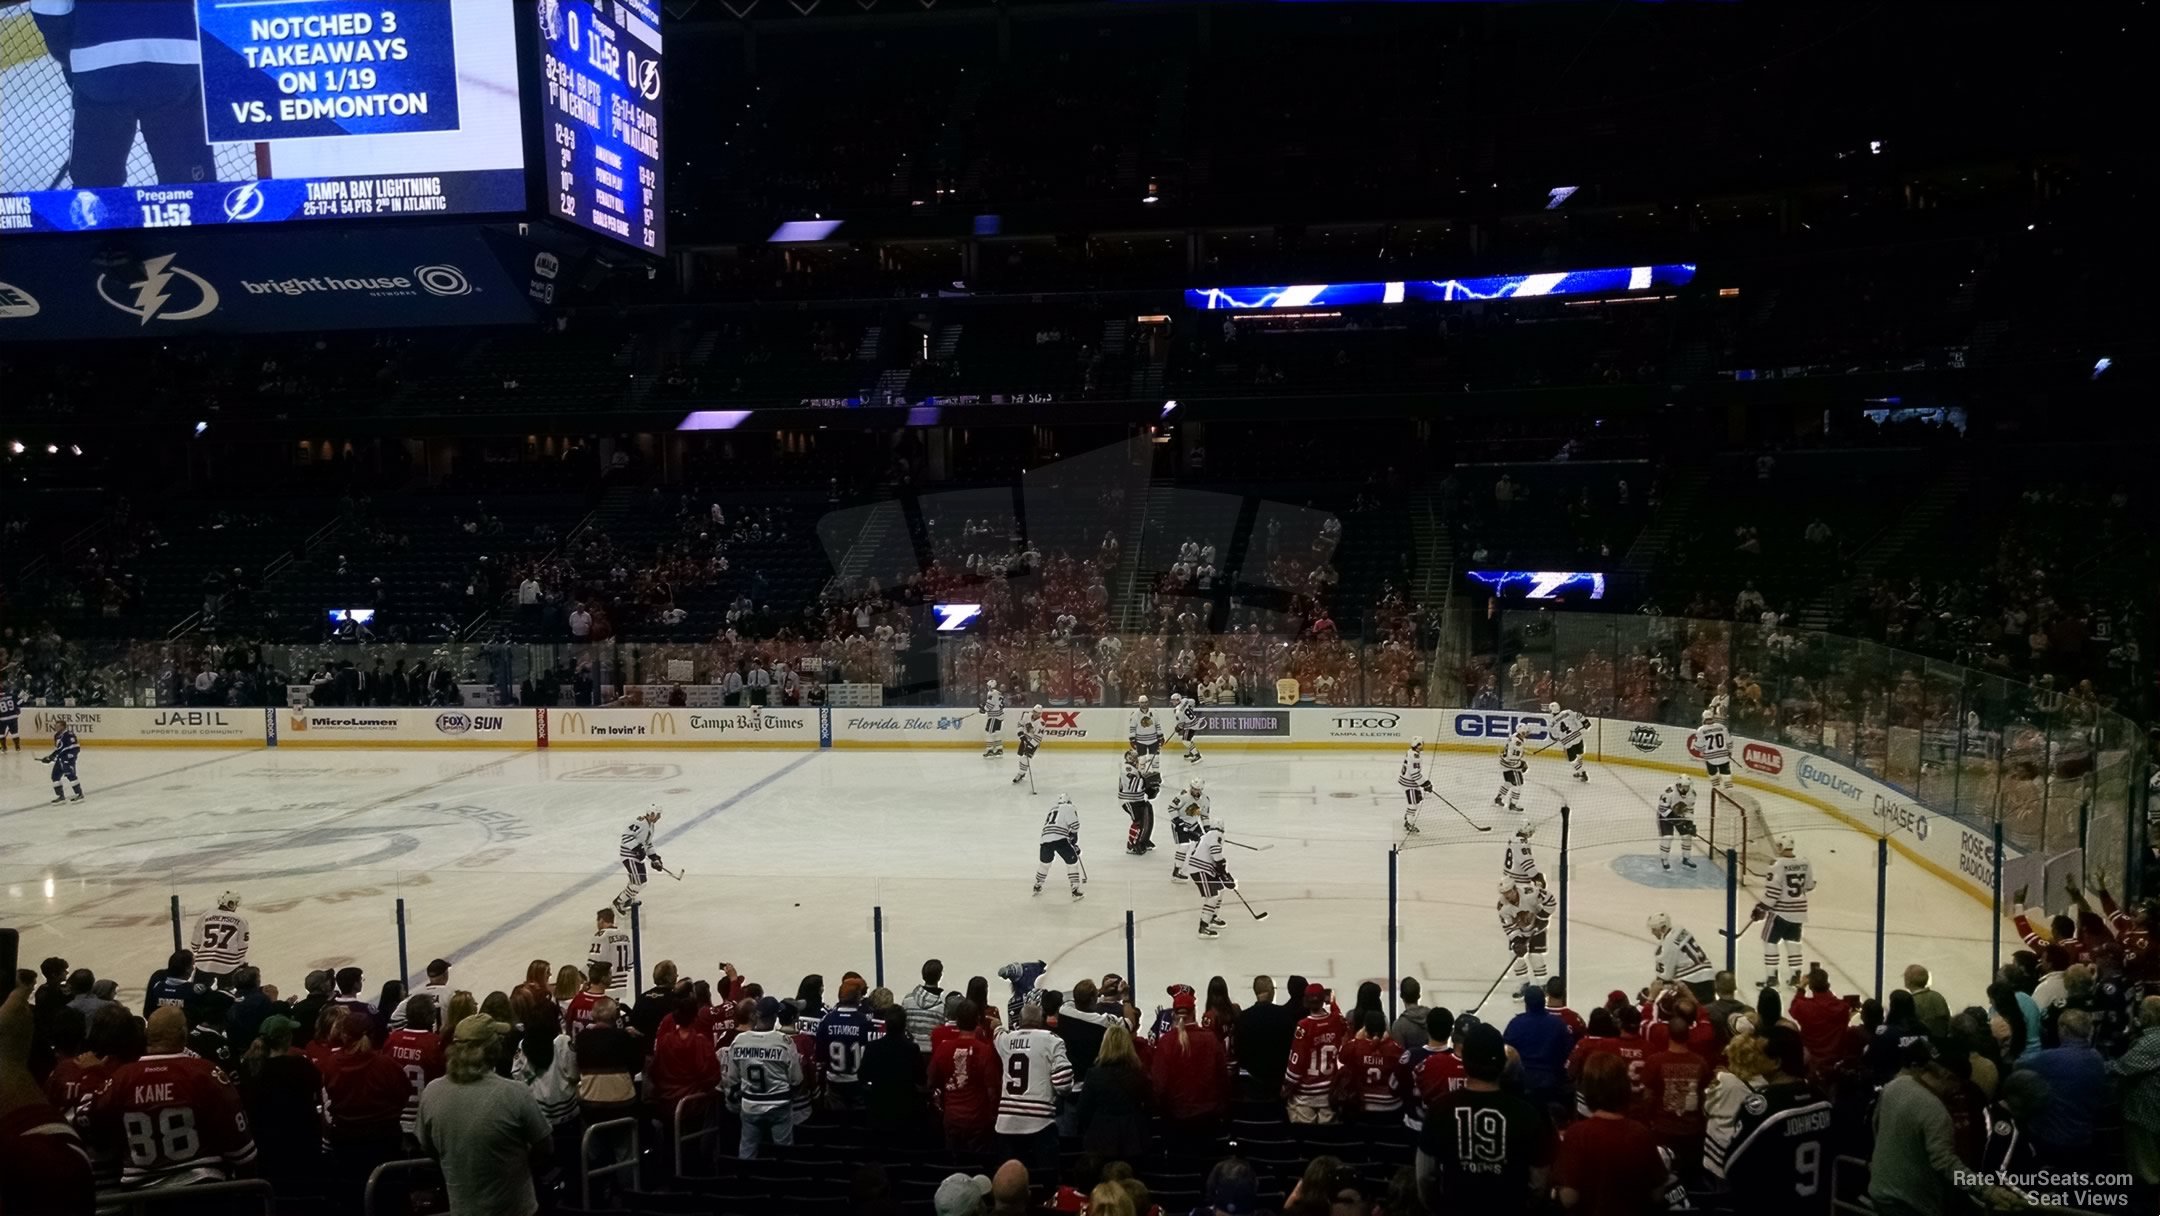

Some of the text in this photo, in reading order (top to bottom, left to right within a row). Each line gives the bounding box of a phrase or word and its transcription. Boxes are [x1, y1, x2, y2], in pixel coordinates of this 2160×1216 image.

[251, 12, 397, 42] NOTCHED 3
[568, 10, 579, 51] 0
[245, 38, 408, 69] TAKEAWAYS
[588, 29, 620, 80] 11:52
[545, 53, 575, 91] 32-13-4
[587, 79, 601, 106] PTS
[627, 50, 637, 88] 0
[278, 69, 377, 95] ON 1/19
[232, 92, 428, 124] VS. EDMONTON
[560, 86, 569, 113] IN
[569, 92, 600, 129] CENTRAL
[636, 107, 646, 128] 54
[645, 112, 658, 138] PTS
[622, 120, 631, 145] IN
[630, 126, 659, 160] ATLANTIC
[136, 189, 194, 204] Pregame
[306, 177, 441, 201] TAMPA BAY LIGHTNING
[141, 203, 192, 228] 11:52
[304, 199, 338, 215] 25-17-4
[341, 198, 353, 213] 54
[354, 197, 373, 213] PTS
[391, 196, 402, 211] IN
[403, 194, 446, 211] ATLANTIC
[241, 276, 412, 296] bright house
[0, 700, 15, 713] 89
[45, 713, 101, 722] LASER SPINE
[154, 712, 229, 726] JABIL
[312, 717, 398, 726] MicroLumen
[443, 716, 464, 726] FOX
[474, 716, 503, 730] SUN
[638, 726, 645, 734] it
[690, 715, 734, 730] Tampa
[764, 715, 804, 729] Times
[820, 708, 828, 739] Reebok
[847, 718, 900, 730] Florida
[1209, 717, 1278, 730] BE THE THUNDER
[1332, 718, 1398, 729] TECO
[1629, 732, 1666, 746] NHL
[1705, 733, 1724, 750] 70
[1745, 749, 1781, 767] AMALIE
[1801, 764, 1863, 801] BUD LIGHT
[1873, 793, 1915, 834] CHASE
[1961, 830, 1985, 861] ROSE
[203, 923, 237, 949] 57
[590, 943, 601, 953] 11
[393, 1046, 422, 1061] TOEWS
[1009, 1039, 1031, 1050] HULL
[1363, 1055, 1384, 1066] KEITH
[746, 1064, 766, 1093] 9
[1006, 1053, 1030, 1096] 9
[135, 1082, 174, 1104] KANE
[1455, 1106, 1506, 1161] 19
[1784, 1110, 1832, 1137] JOHNSON
[123, 1106, 200, 1167] 88
[1795, 1140, 1820, 1196] 9
